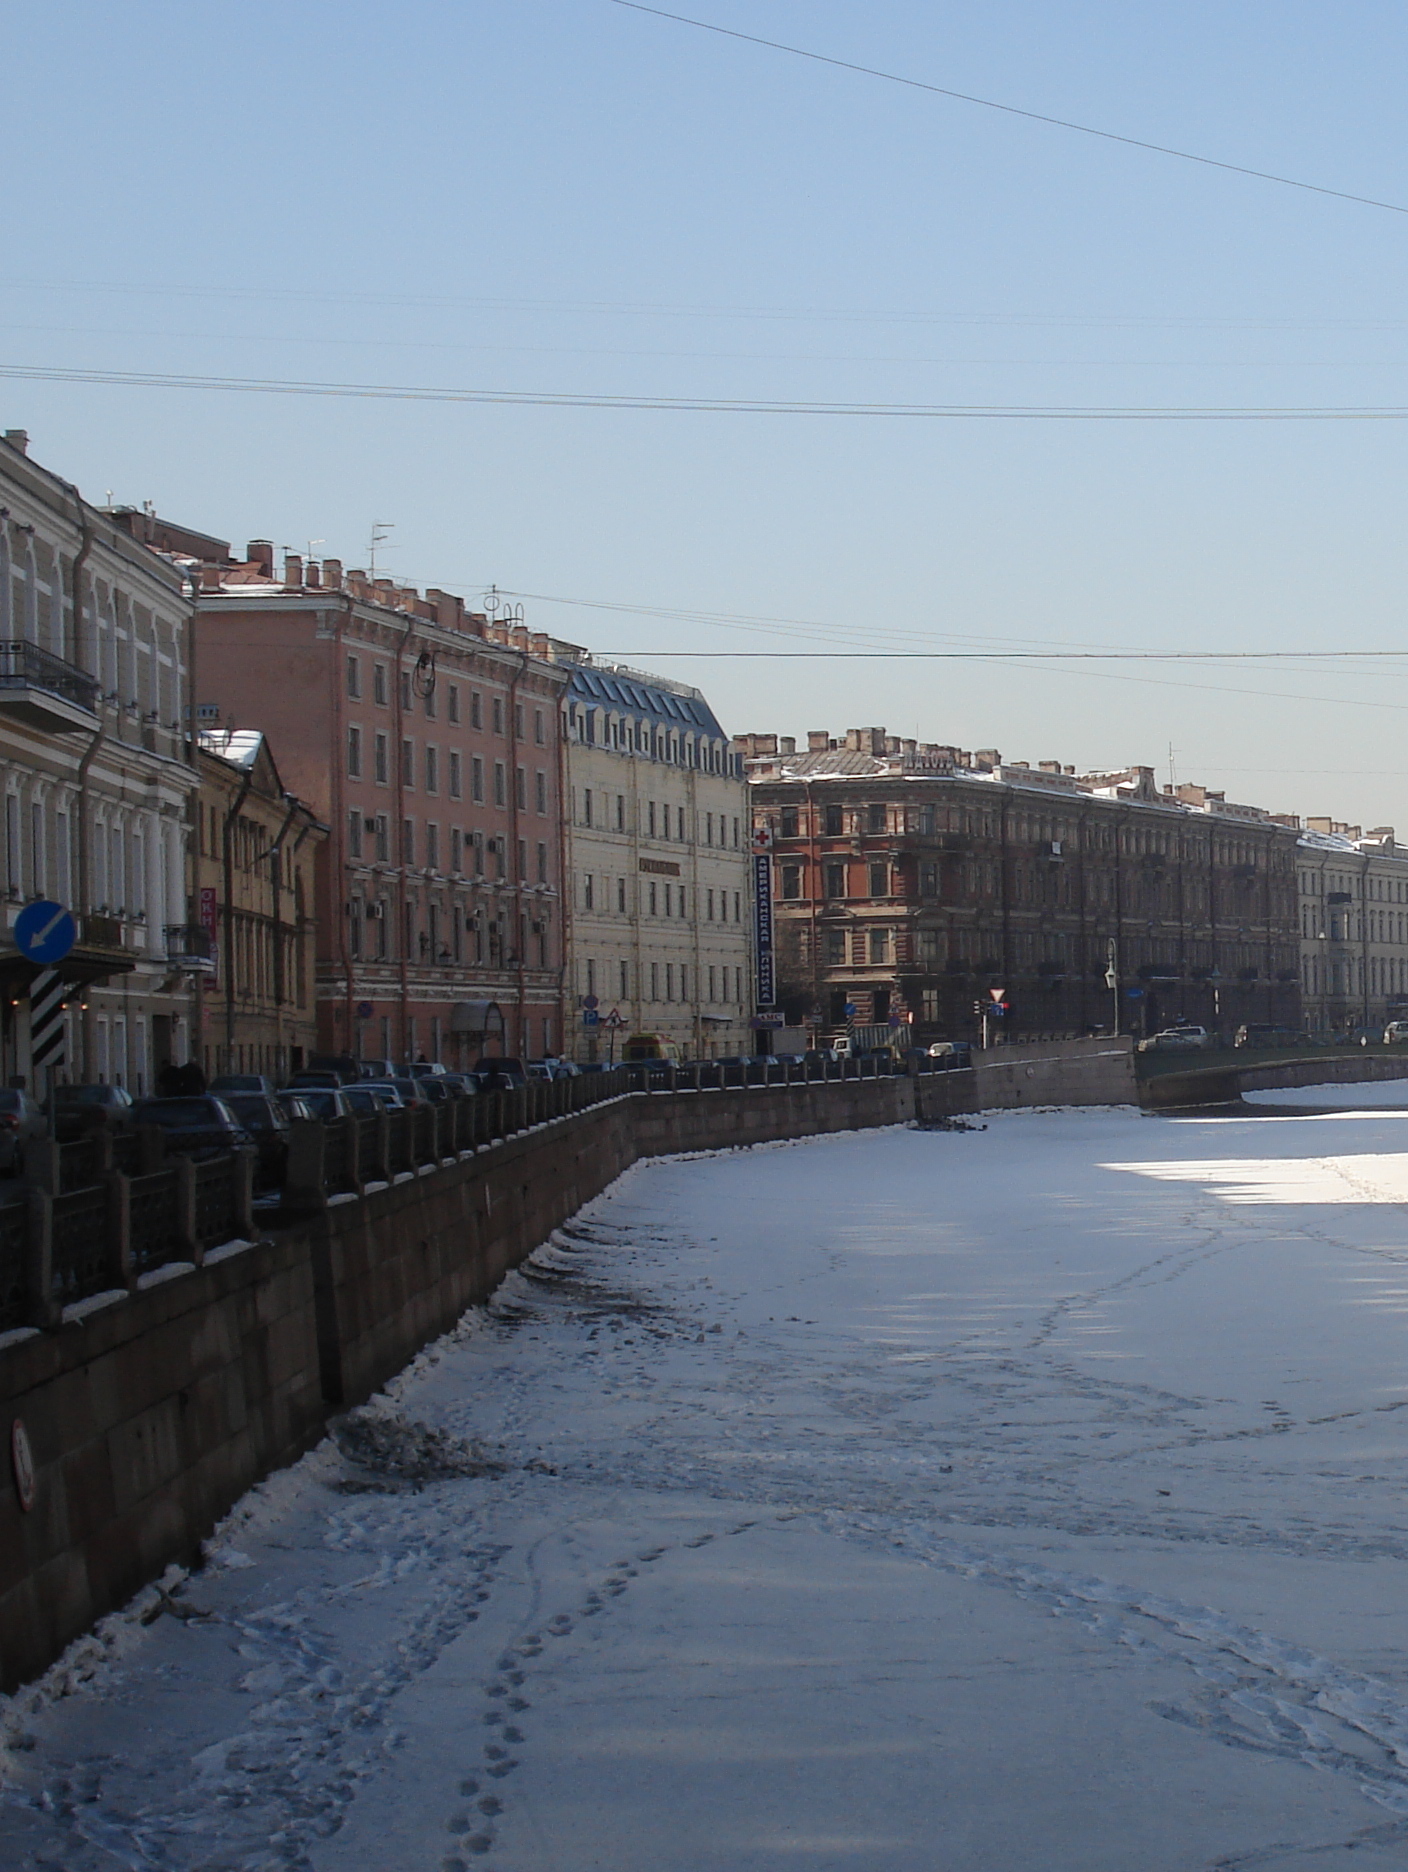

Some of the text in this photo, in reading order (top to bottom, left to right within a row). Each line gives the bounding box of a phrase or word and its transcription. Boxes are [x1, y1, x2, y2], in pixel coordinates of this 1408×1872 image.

[201, 889, 213, 936] ОКН
[759, 857, 769, 942] АМЕРИКАНСКАЯ
[586, 1012, 596, 1025] P
